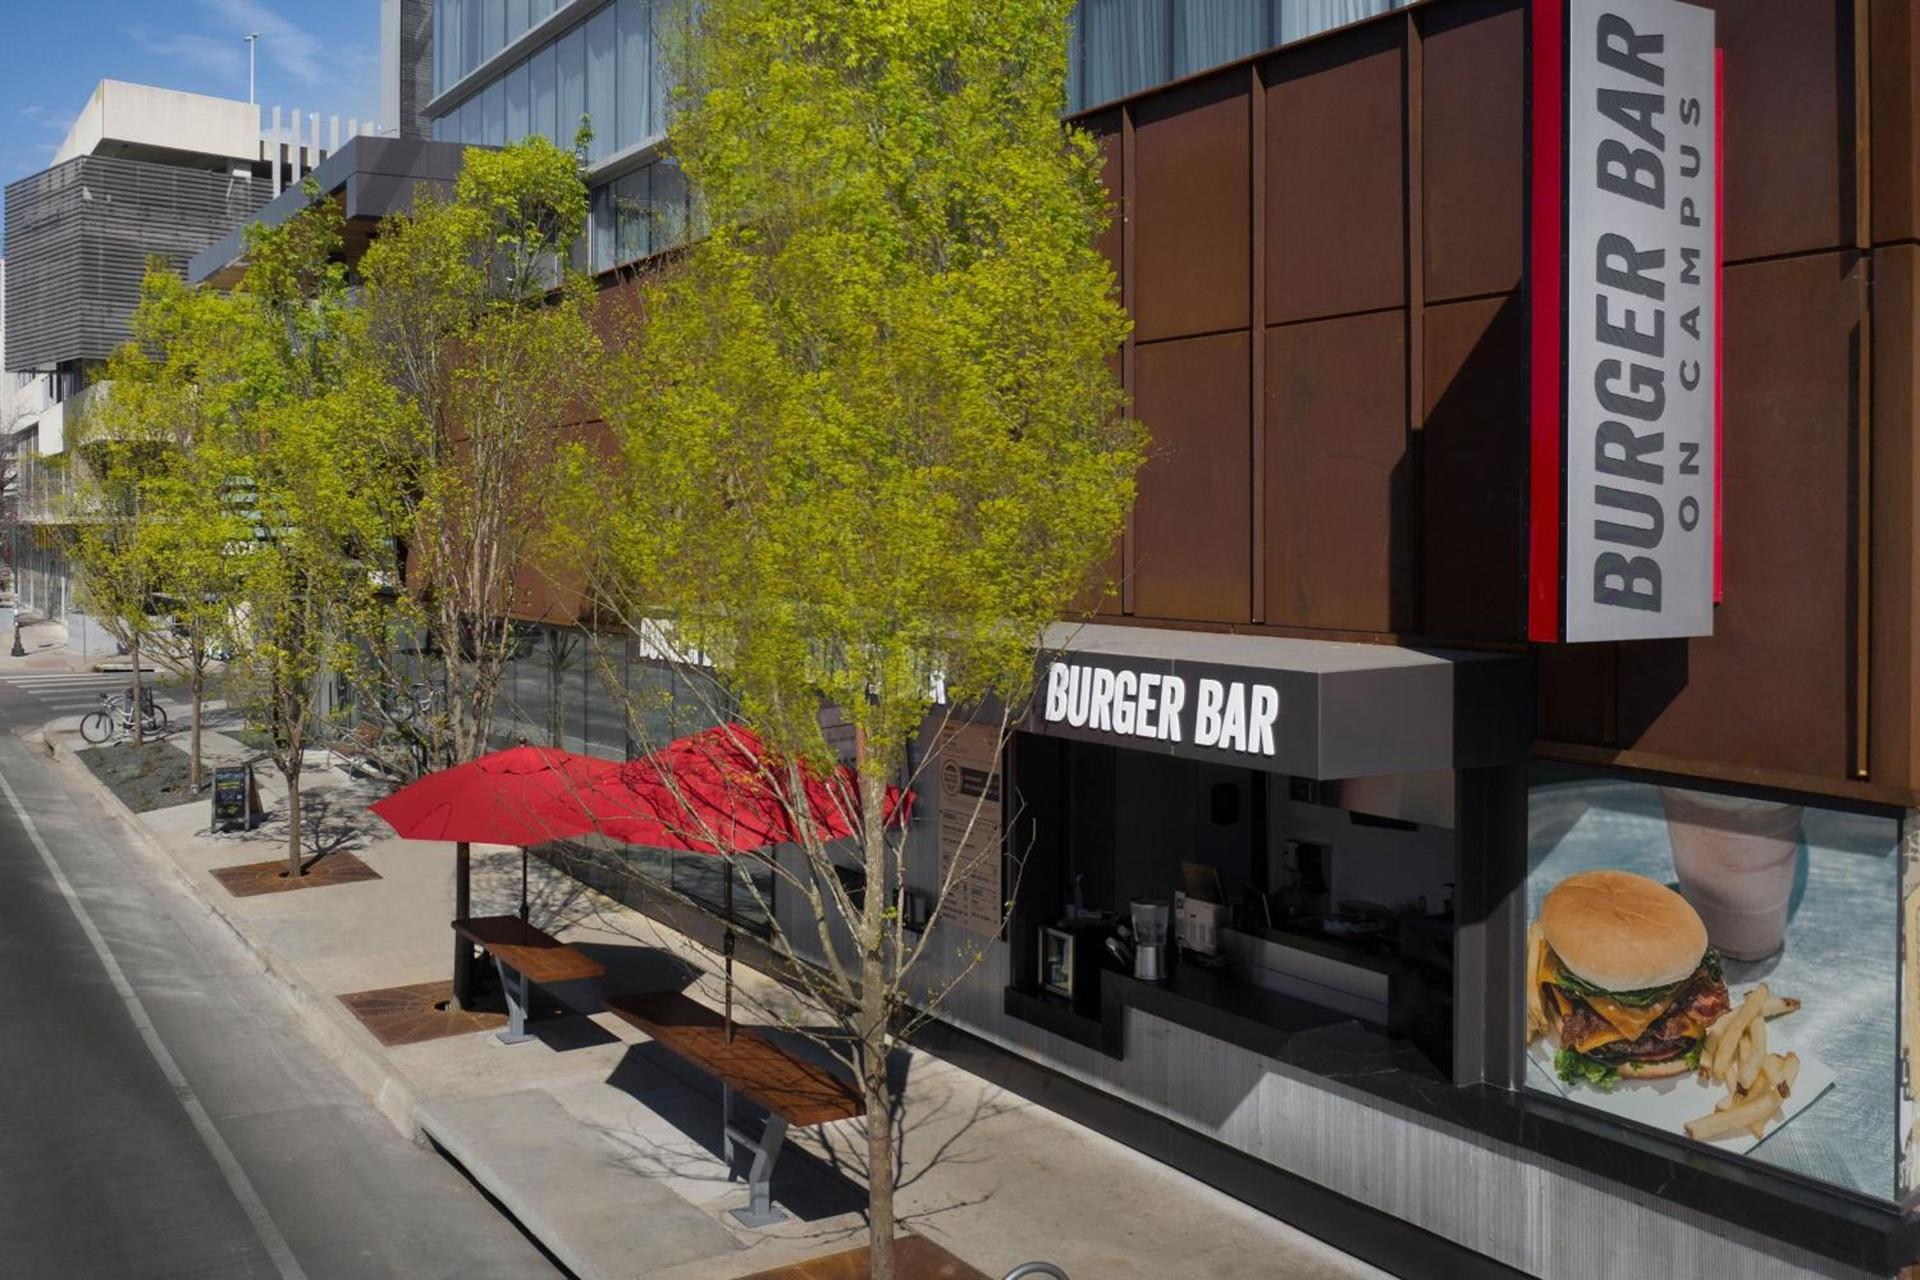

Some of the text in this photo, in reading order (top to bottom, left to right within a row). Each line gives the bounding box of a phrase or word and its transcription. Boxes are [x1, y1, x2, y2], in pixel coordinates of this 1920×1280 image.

[1593, 12, 1666, 613] BURGER BAR
[1678, 97, 1701, 532] ON CAMPUS
[1045, 662, 1279, 756] BURGER BAR
